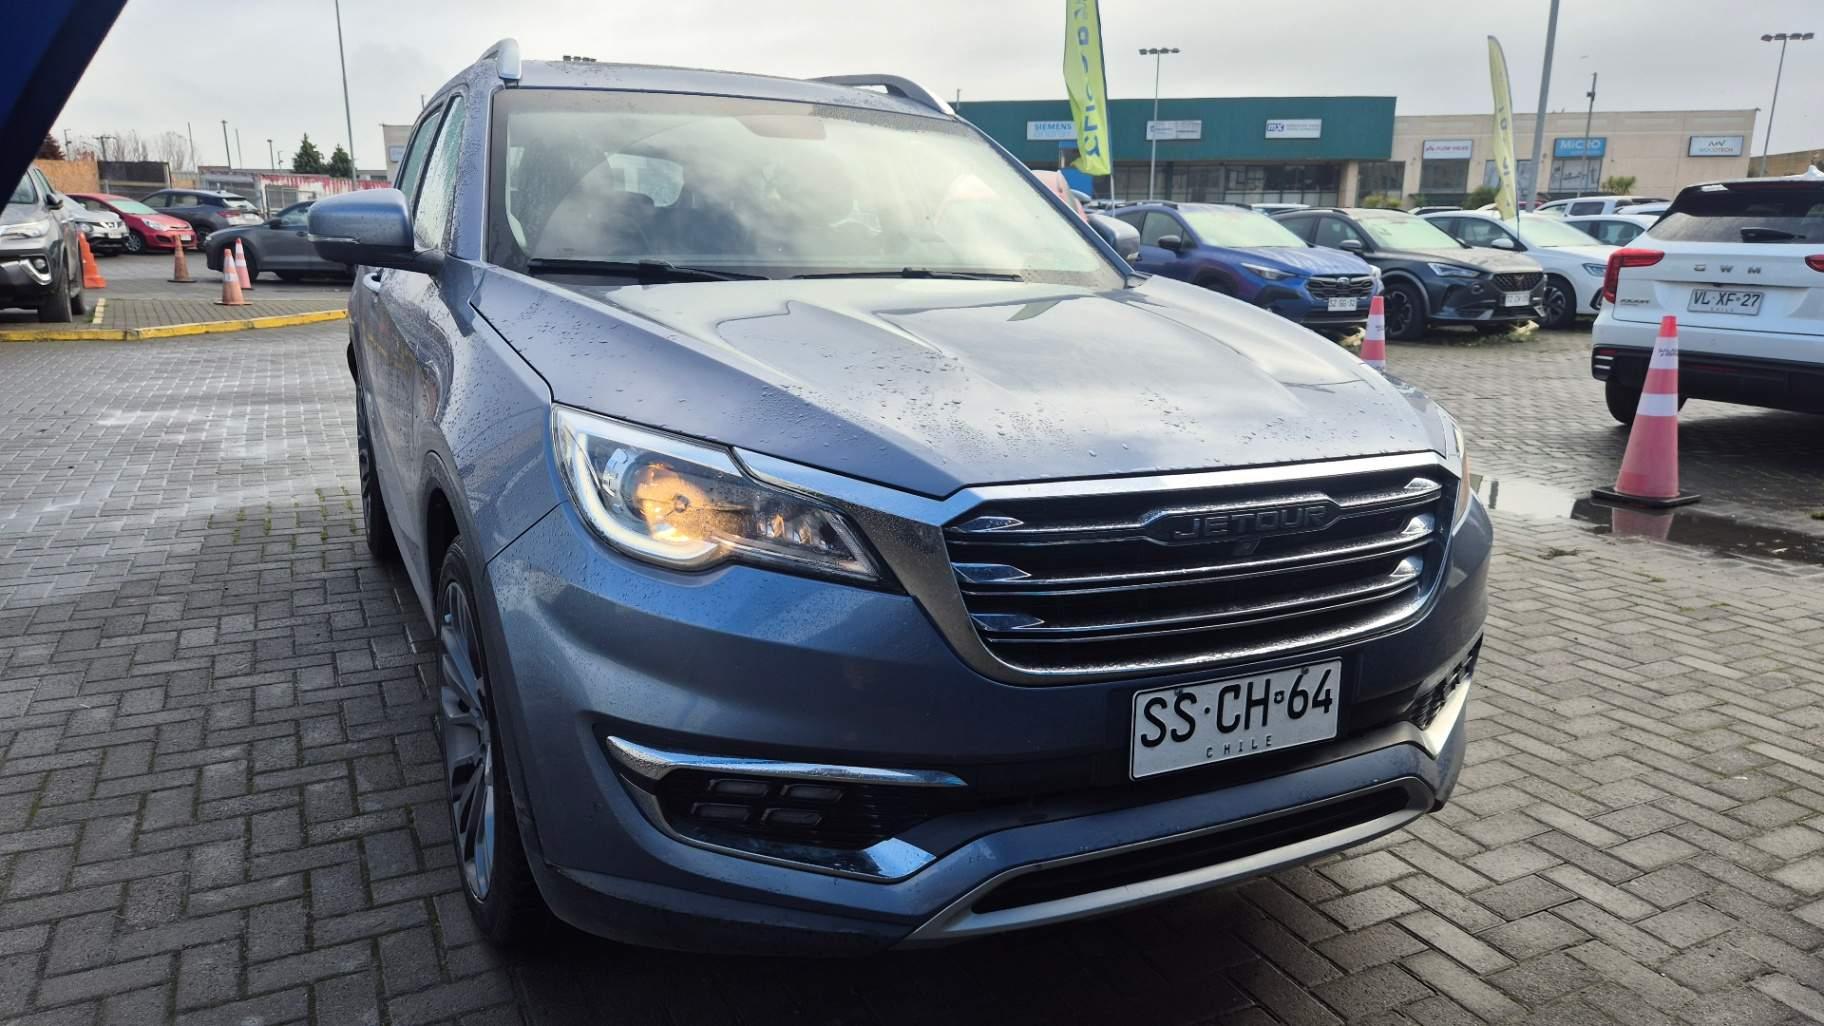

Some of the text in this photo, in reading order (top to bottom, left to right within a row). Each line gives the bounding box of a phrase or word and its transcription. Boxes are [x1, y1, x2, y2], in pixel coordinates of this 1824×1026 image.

[1034, 122, 1072, 130] SIEMENS
[1174, 505, 1326, 539] JETOUR
[1206, 735, 1273, 758] CHILE
